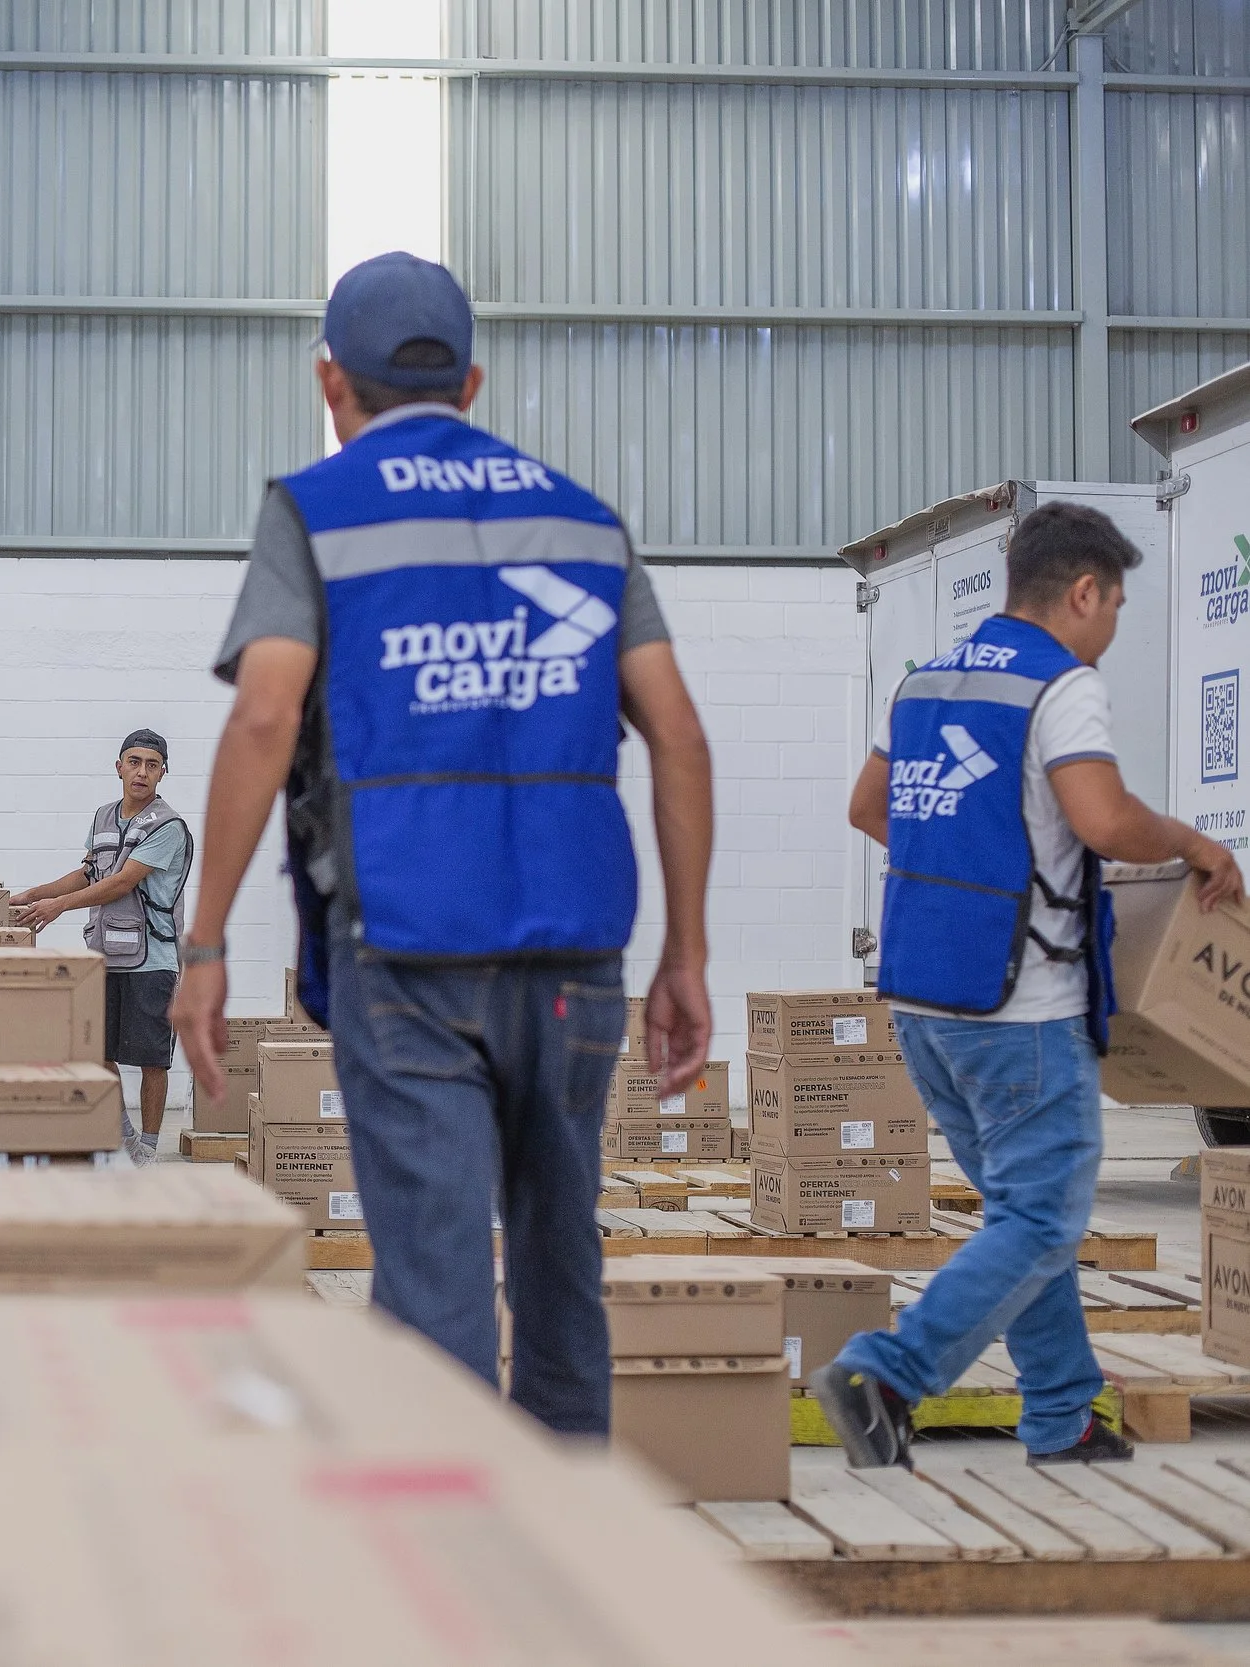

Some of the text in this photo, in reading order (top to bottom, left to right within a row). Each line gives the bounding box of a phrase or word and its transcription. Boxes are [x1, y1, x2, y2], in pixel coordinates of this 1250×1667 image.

[378, 455, 555, 493] DRIVER
[952, 569, 992, 601] SERVICIOS
[1200, 555, 1238, 597] movi
[1206, 588, 1249, 625] carga
[379, 604, 528, 670] movi
[415, 656, 581, 711] carga
[1195, 809, 1246, 832] 800 711 36 07
[756, 1010, 776, 1025] AVON
[754, 1088, 778, 1108] AVON
[758, 1174, 781, 1194] AVON
[1213, 1186, 1246, 1209] AVON
[1214, 1264, 1250, 1297] AVON
